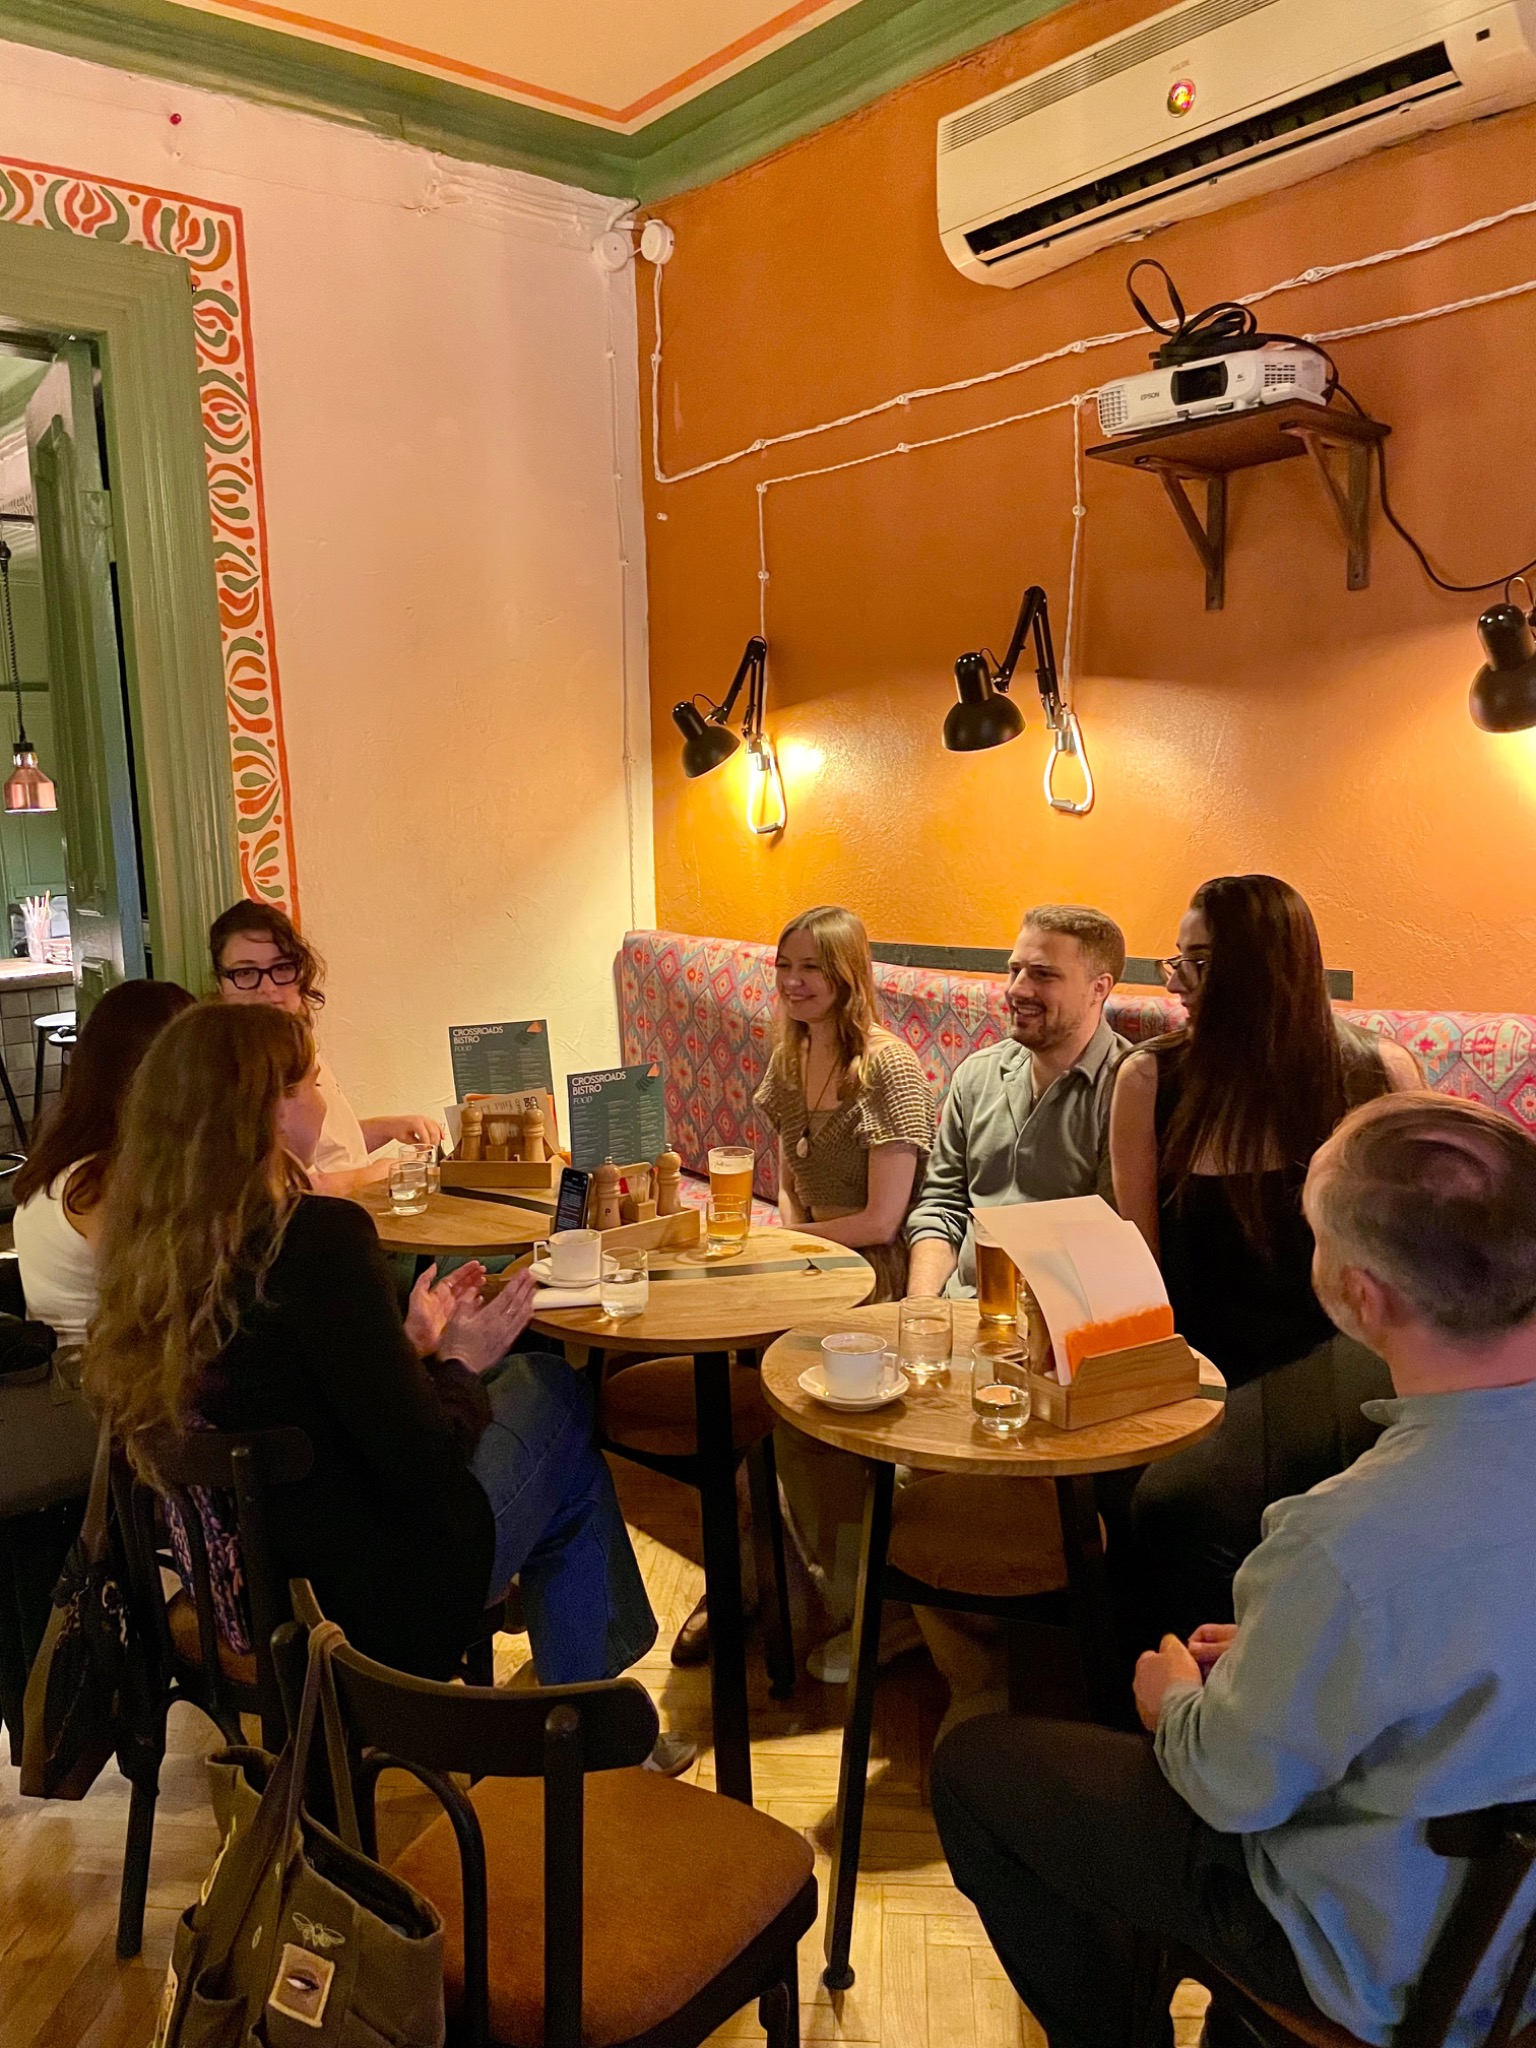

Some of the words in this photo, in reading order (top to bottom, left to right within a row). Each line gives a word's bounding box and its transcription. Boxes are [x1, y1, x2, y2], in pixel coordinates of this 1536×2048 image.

[1140, 391, 1160, 401] EPSON
[452, 1026, 504, 1037] CROSSROADS
[453, 1035, 480, 1045] BISTRO
[571, 1071, 627, 1087] CROSSROADS
[572, 1084, 602, 1096] BISTRO
[573, 1095, 593, 1105] FOOD
